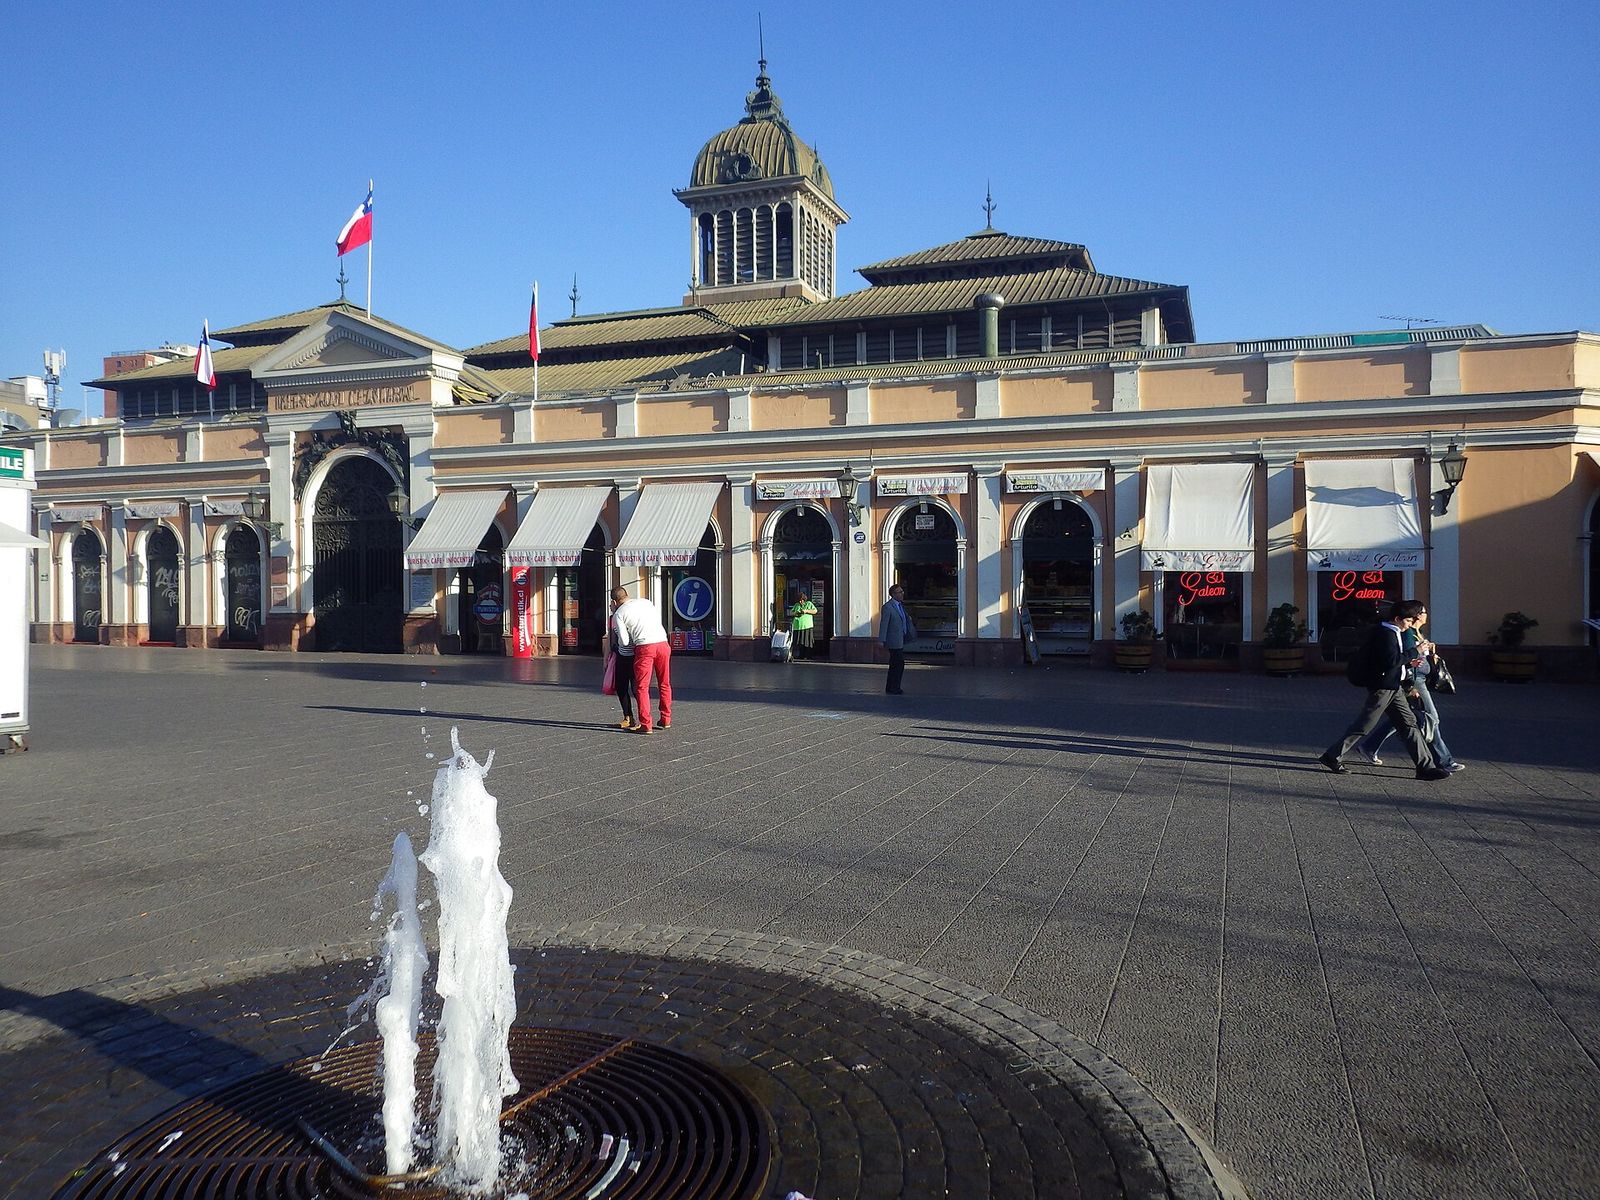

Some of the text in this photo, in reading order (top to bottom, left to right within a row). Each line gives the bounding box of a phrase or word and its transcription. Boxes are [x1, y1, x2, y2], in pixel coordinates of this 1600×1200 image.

[618, 555, 642, 563] TURISTIK
[663, 554, 695, 562] INFOCENTER
[1178, 571, 1226, 606] Galeon
[1332, 570, 1385, 601] Galeon
